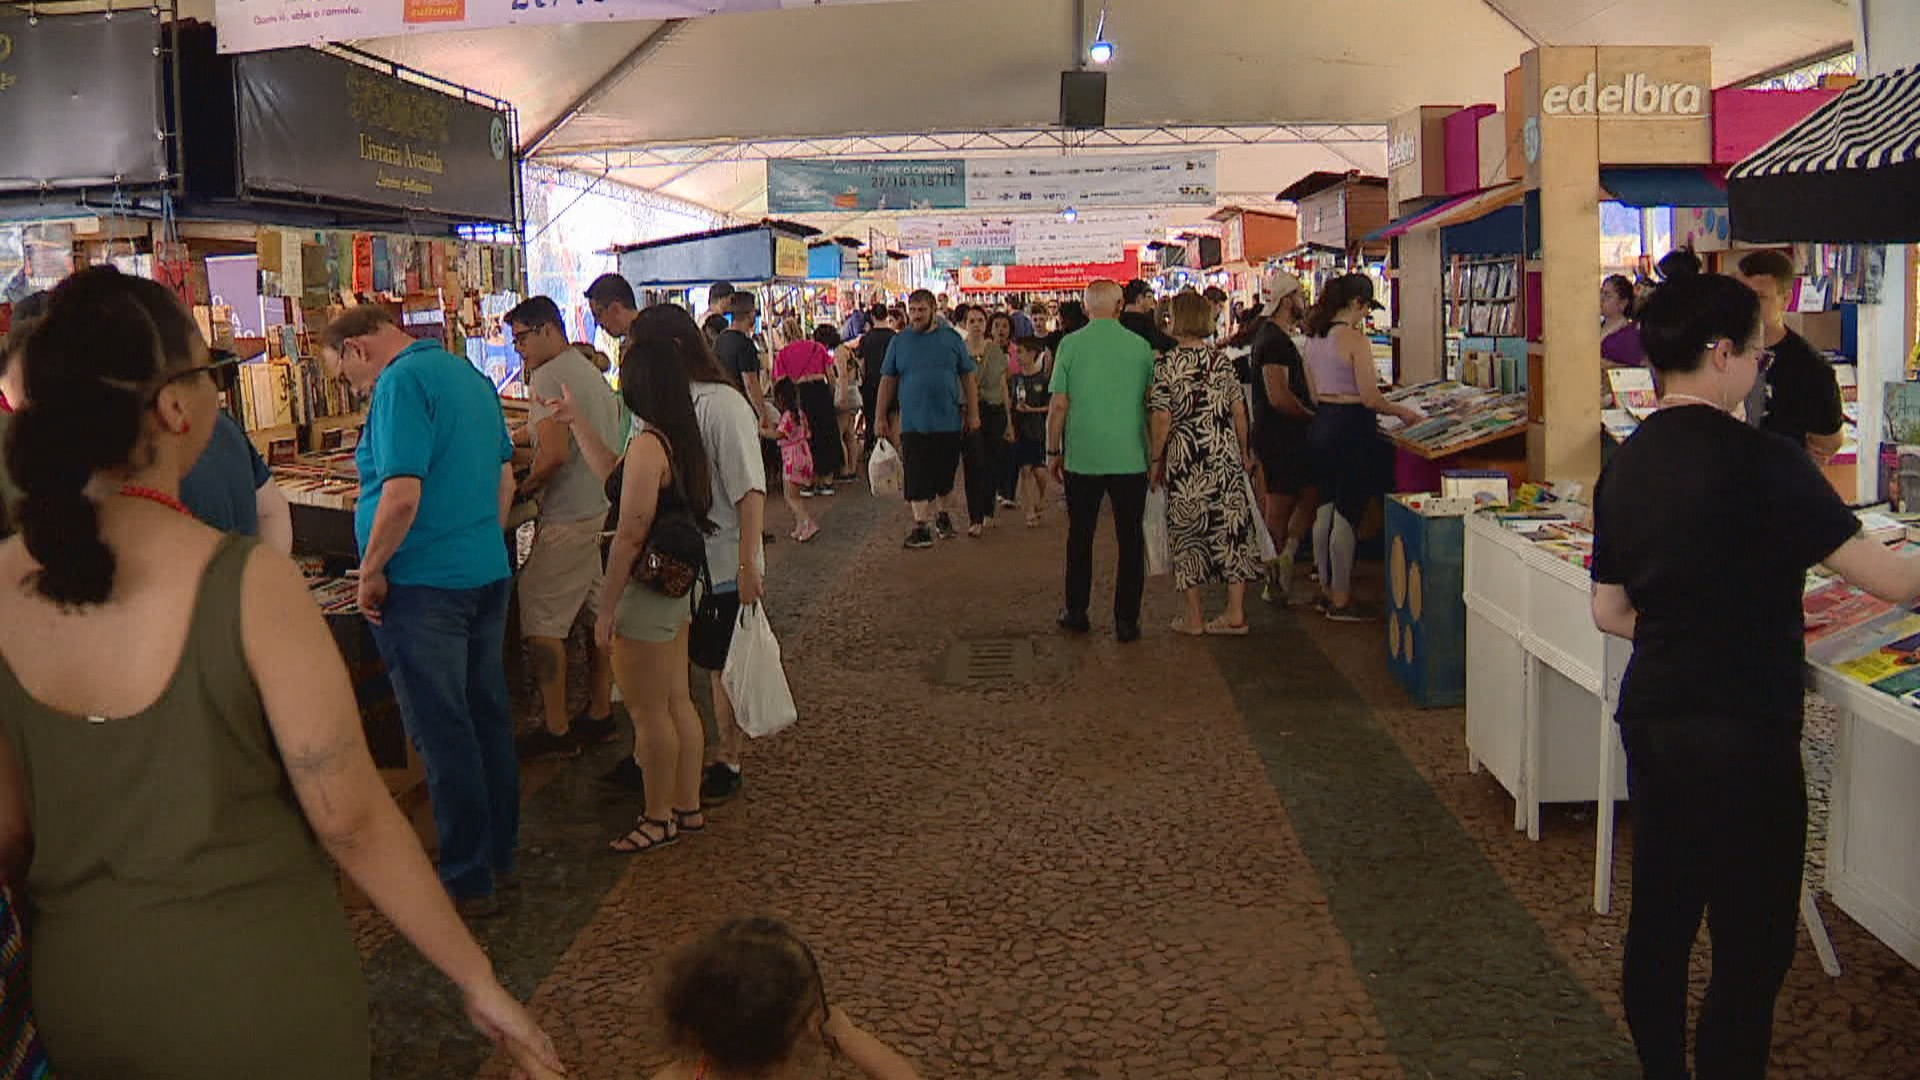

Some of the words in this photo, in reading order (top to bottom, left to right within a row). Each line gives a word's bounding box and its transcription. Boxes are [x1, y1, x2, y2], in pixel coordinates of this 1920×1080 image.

[1542, 72, 1700, 115] edelbra
[359, 133, 400, 167] Livraria
[404, 143, 443, 174] Avenida
